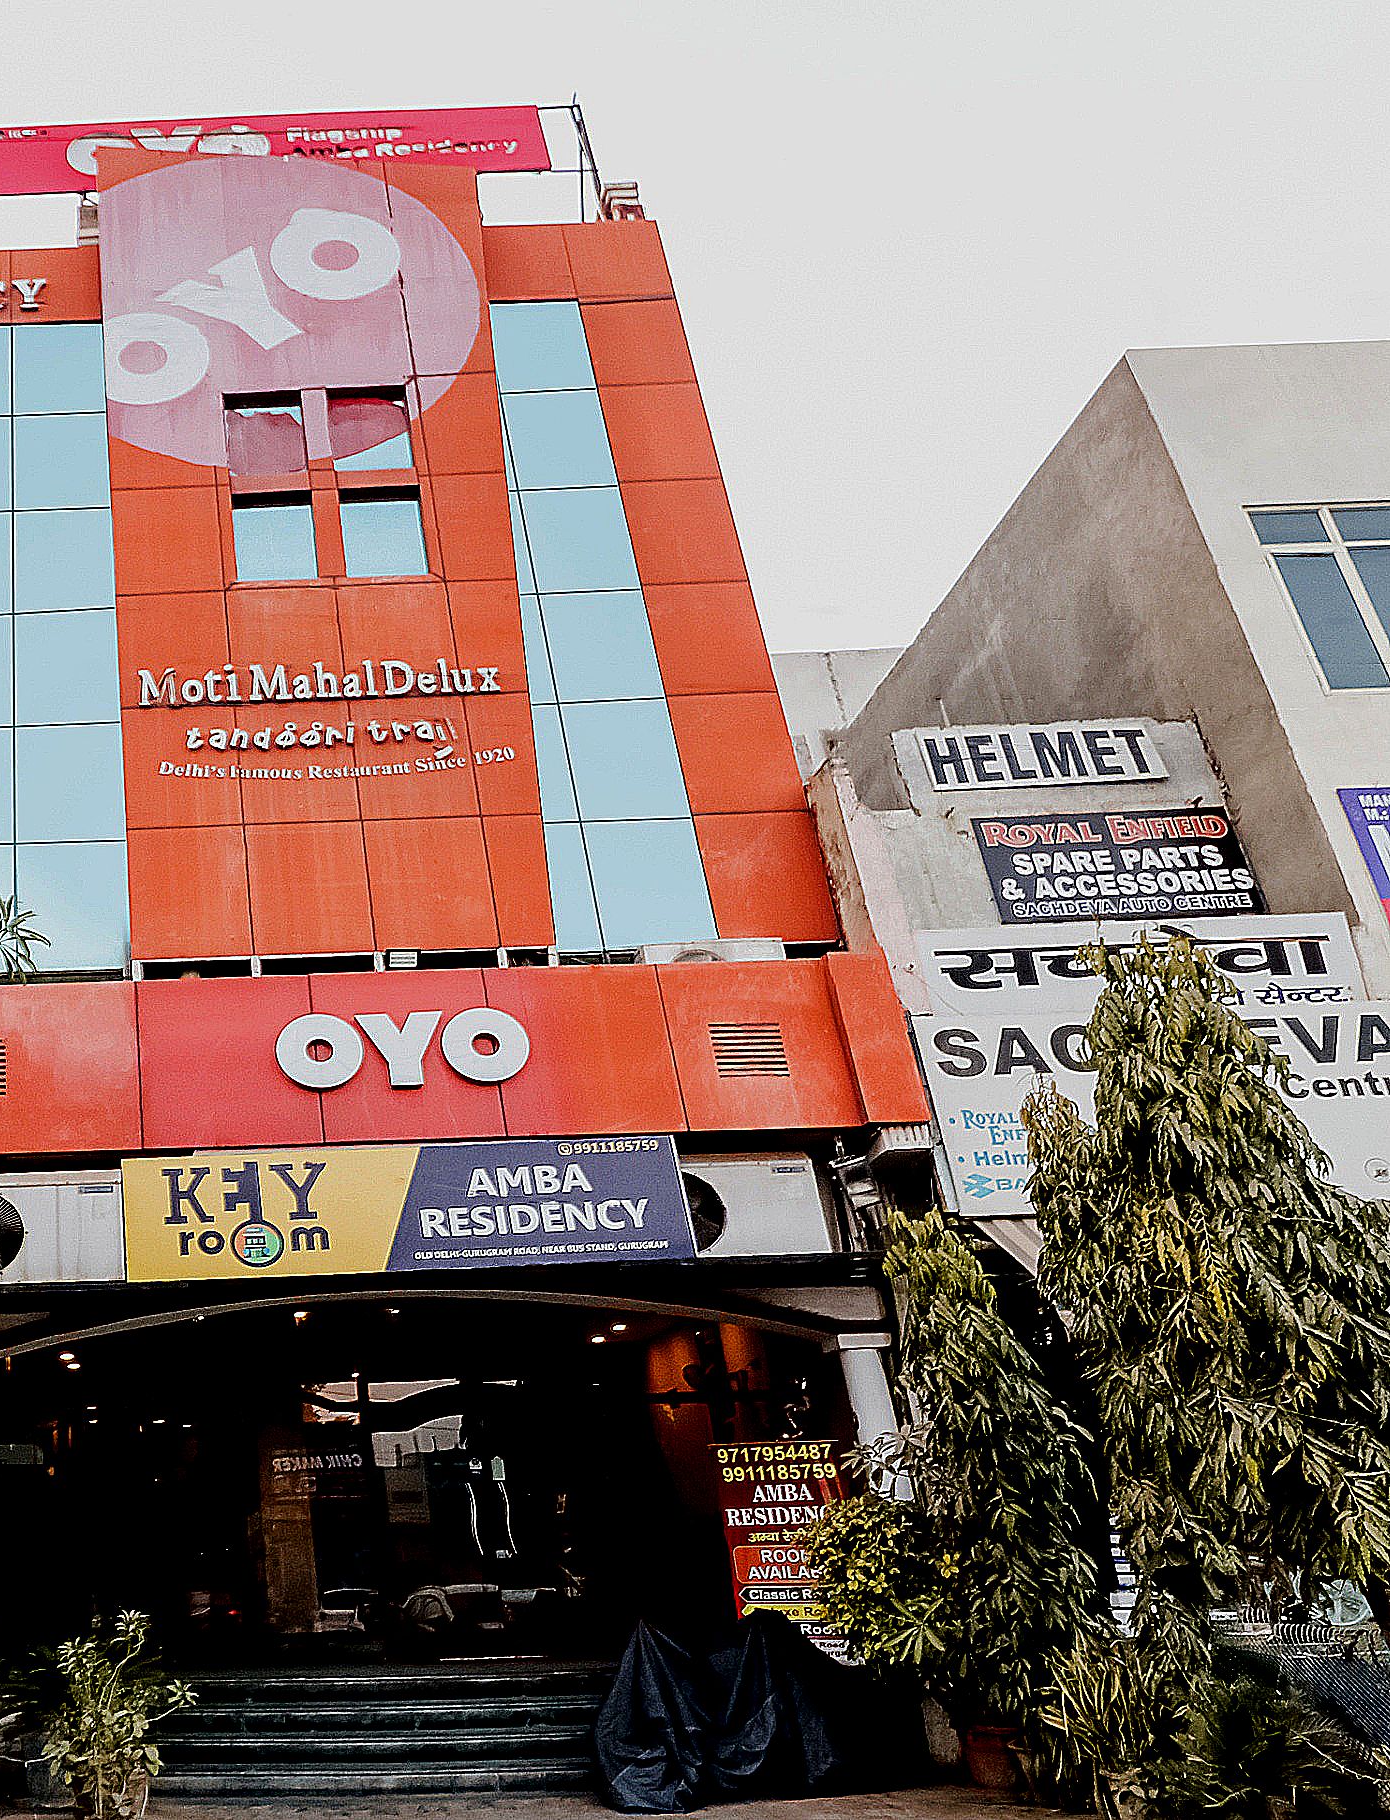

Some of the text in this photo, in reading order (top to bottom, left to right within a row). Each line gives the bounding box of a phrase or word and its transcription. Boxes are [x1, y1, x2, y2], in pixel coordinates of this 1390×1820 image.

[375, 139, 518, 158] Residency
[107, 208, 401, 404] OYO
[137, 658, 502, 706] Moti Mahal Delux
[185, 721, 356, 751] tandoori
[158, 746, 515, 780] Delhi's Famous Restaurant Since 1920
[923, 729, 1152, 786] HELMET
[980, 814, 1228, 848] ROYAL ENFIELD
[1014, 845, 1224, 876] SPARE PARTS
[1001, 868, 1254, 900] & ACCESSORIES
[1012, 893, 1254, 918] SACHDEVA AUTO CENTRE
[275, 1007, 530, 1090] OYO
[961, 1110, 1019, 1129] ROYAL
[574, 1139, 659, 1155] 9911185759
[466, 1164, 593, 1198] AMBA
[419, 1199, 648, 1239] RESIDENCY
[414, 1251, 433, 1260] OLD
[542, 1245, 566, 1255] NEAR
[567, 1244, 585, 1253] BUS
[618, 1240, 669, 1250] GURUGRAM
[717, 1444, 832, 1463] 9717954487
[723, 1463, 837, 1482] 9911185759
[752, 1484, 814, 1503] AMBA
[725, 1506, 827, 1527] RESIDEN
[749, 1589, 800, 1600] Classic
